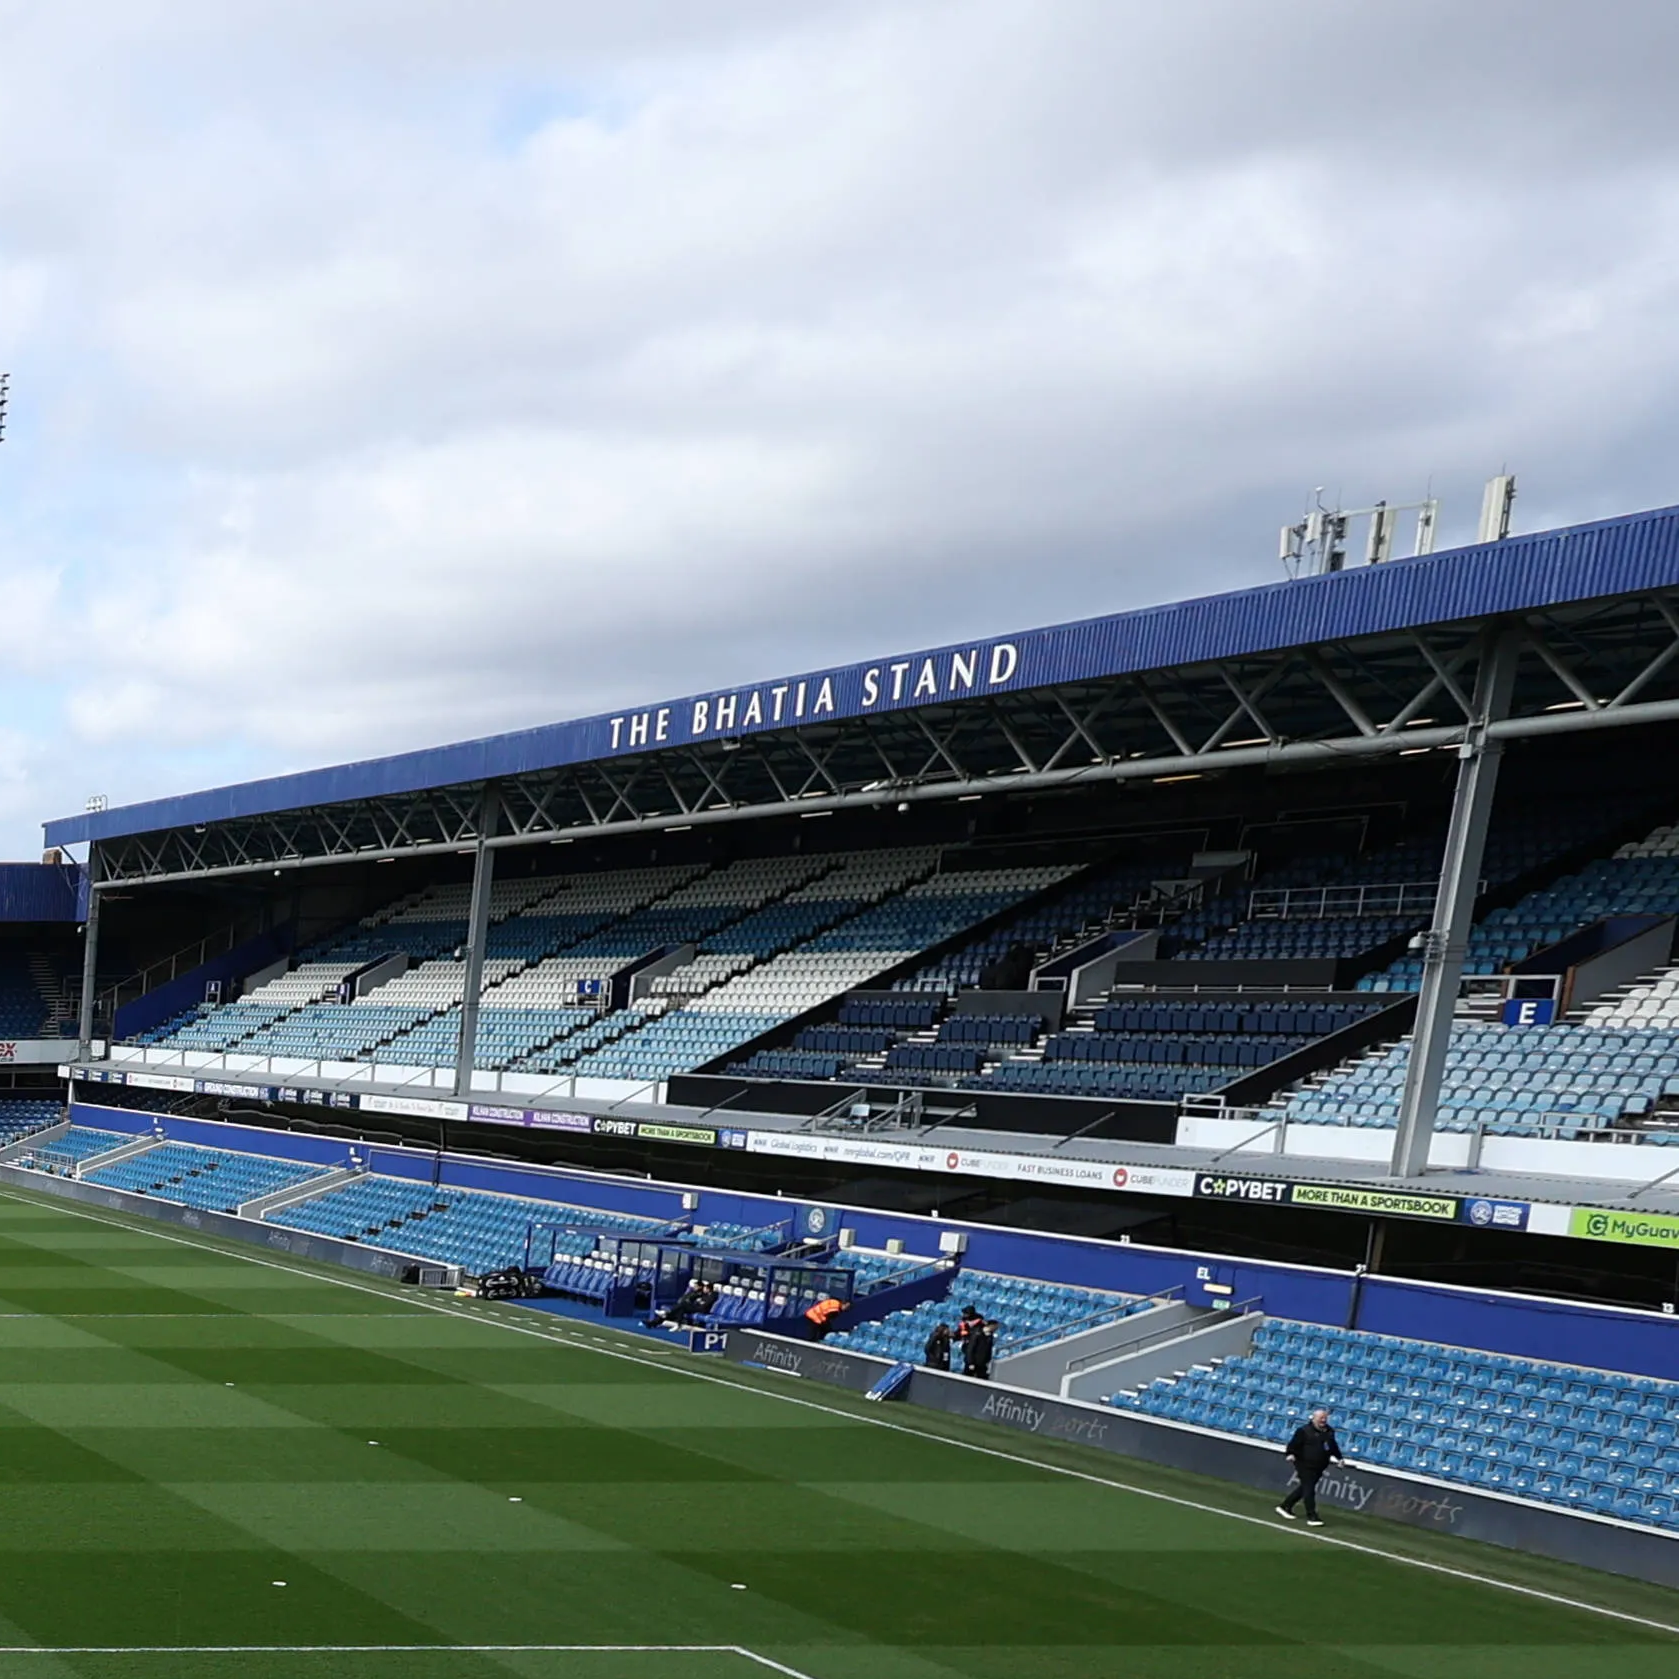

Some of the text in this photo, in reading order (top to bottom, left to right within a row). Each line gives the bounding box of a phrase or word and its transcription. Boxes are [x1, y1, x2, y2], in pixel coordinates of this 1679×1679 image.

[610, 643, 1018, 749] THE BHATIA STAND
[585, 980, 593, 993] C
[1519, 1002, 1538, 1024] E
[1017, 1163, 1103, 1182] FAST BUSINESS LOANS
[1296, 1188, 1450, 1216] MORE THAN A SPORTSBOOK
[704, 1333, 728, 1350] P1
[753, 1342, 802, 1371] Affinity
[981, 1393, 1045, 1432] Affinity
